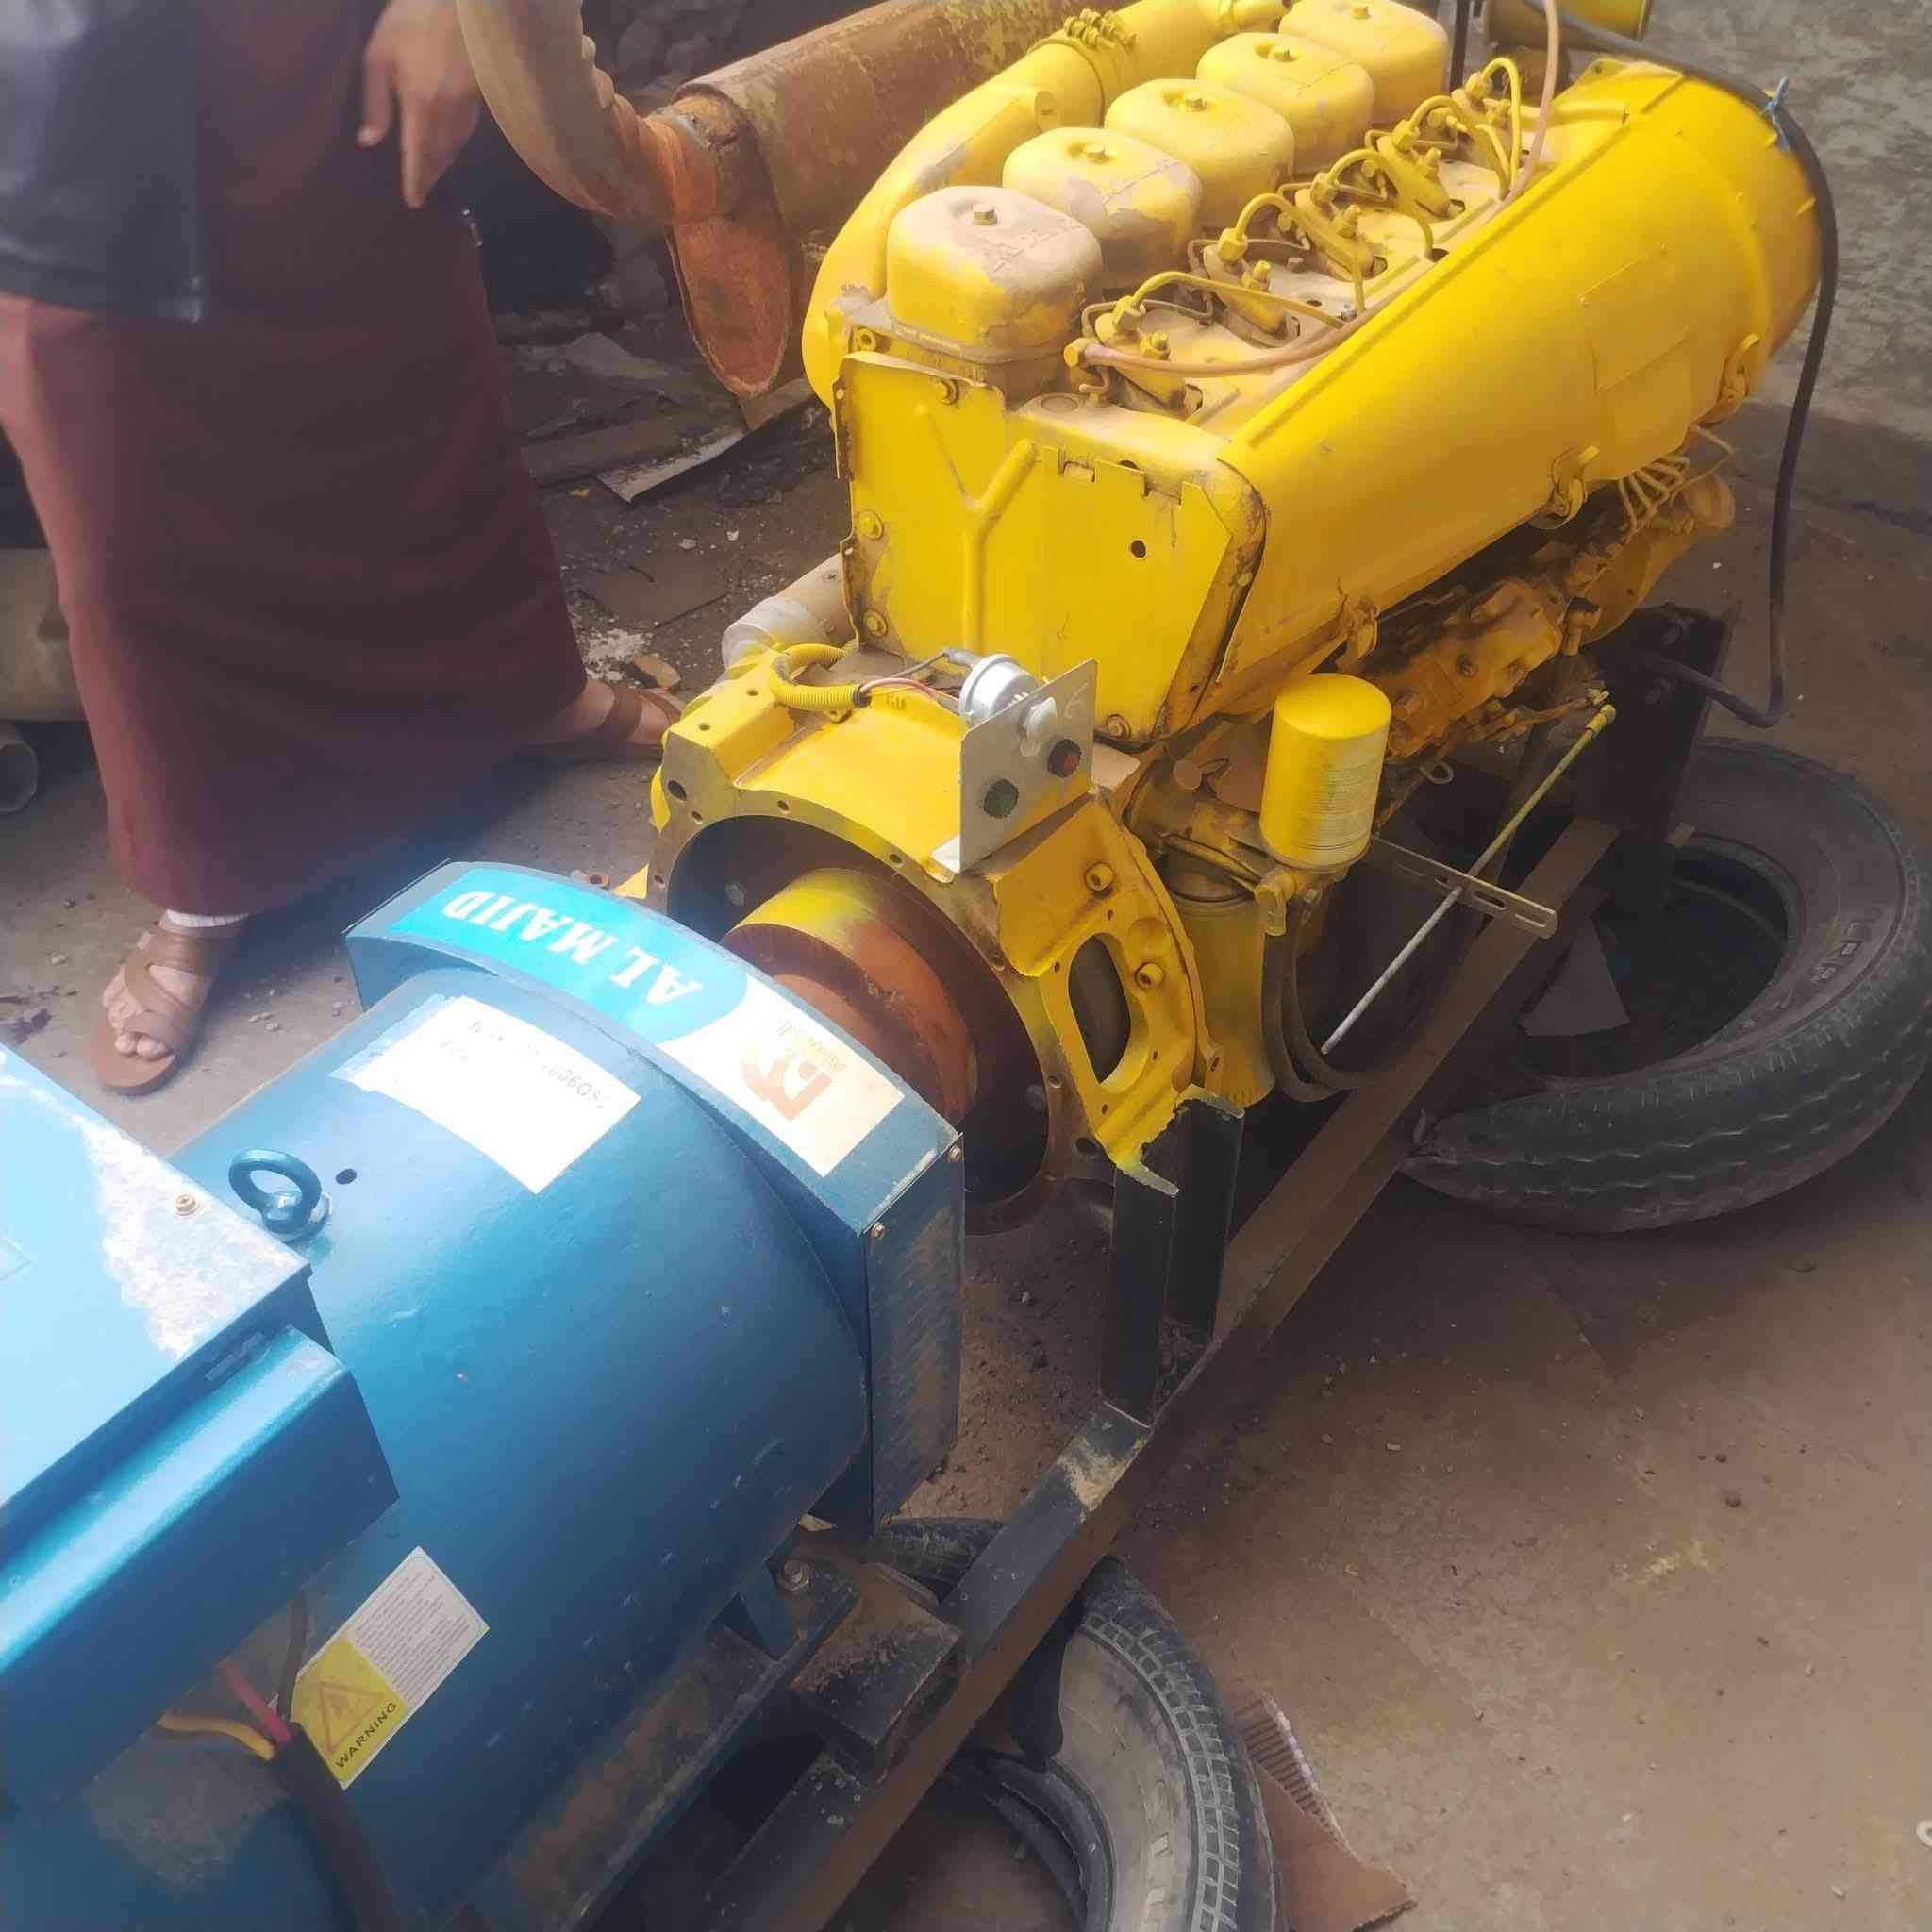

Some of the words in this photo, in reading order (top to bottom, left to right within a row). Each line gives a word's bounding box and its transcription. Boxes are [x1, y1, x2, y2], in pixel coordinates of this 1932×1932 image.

[442, 890, 621, 966] MAJID
[609, 944, 703, 1008] AL
[335, 1701, 398, 1769] WARNING
